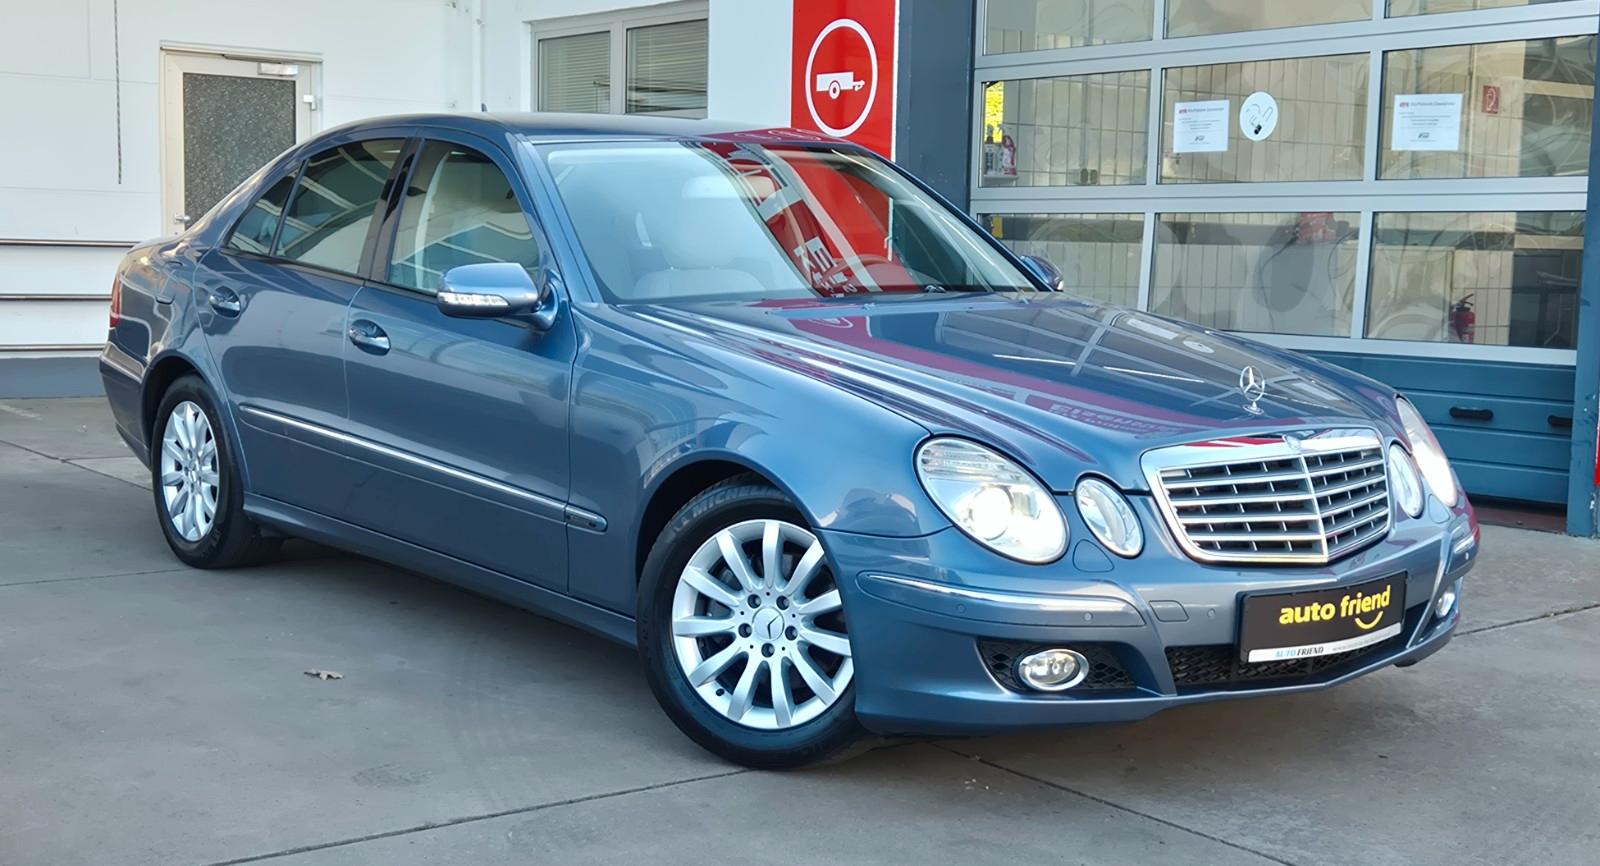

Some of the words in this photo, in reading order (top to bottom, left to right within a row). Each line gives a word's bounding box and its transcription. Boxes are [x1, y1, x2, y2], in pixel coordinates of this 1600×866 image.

[1279, 603, 1335, 624] auto
[1341, 585, 1391, 617] friend
[1297, 646, 1324, 656] FRIEND
